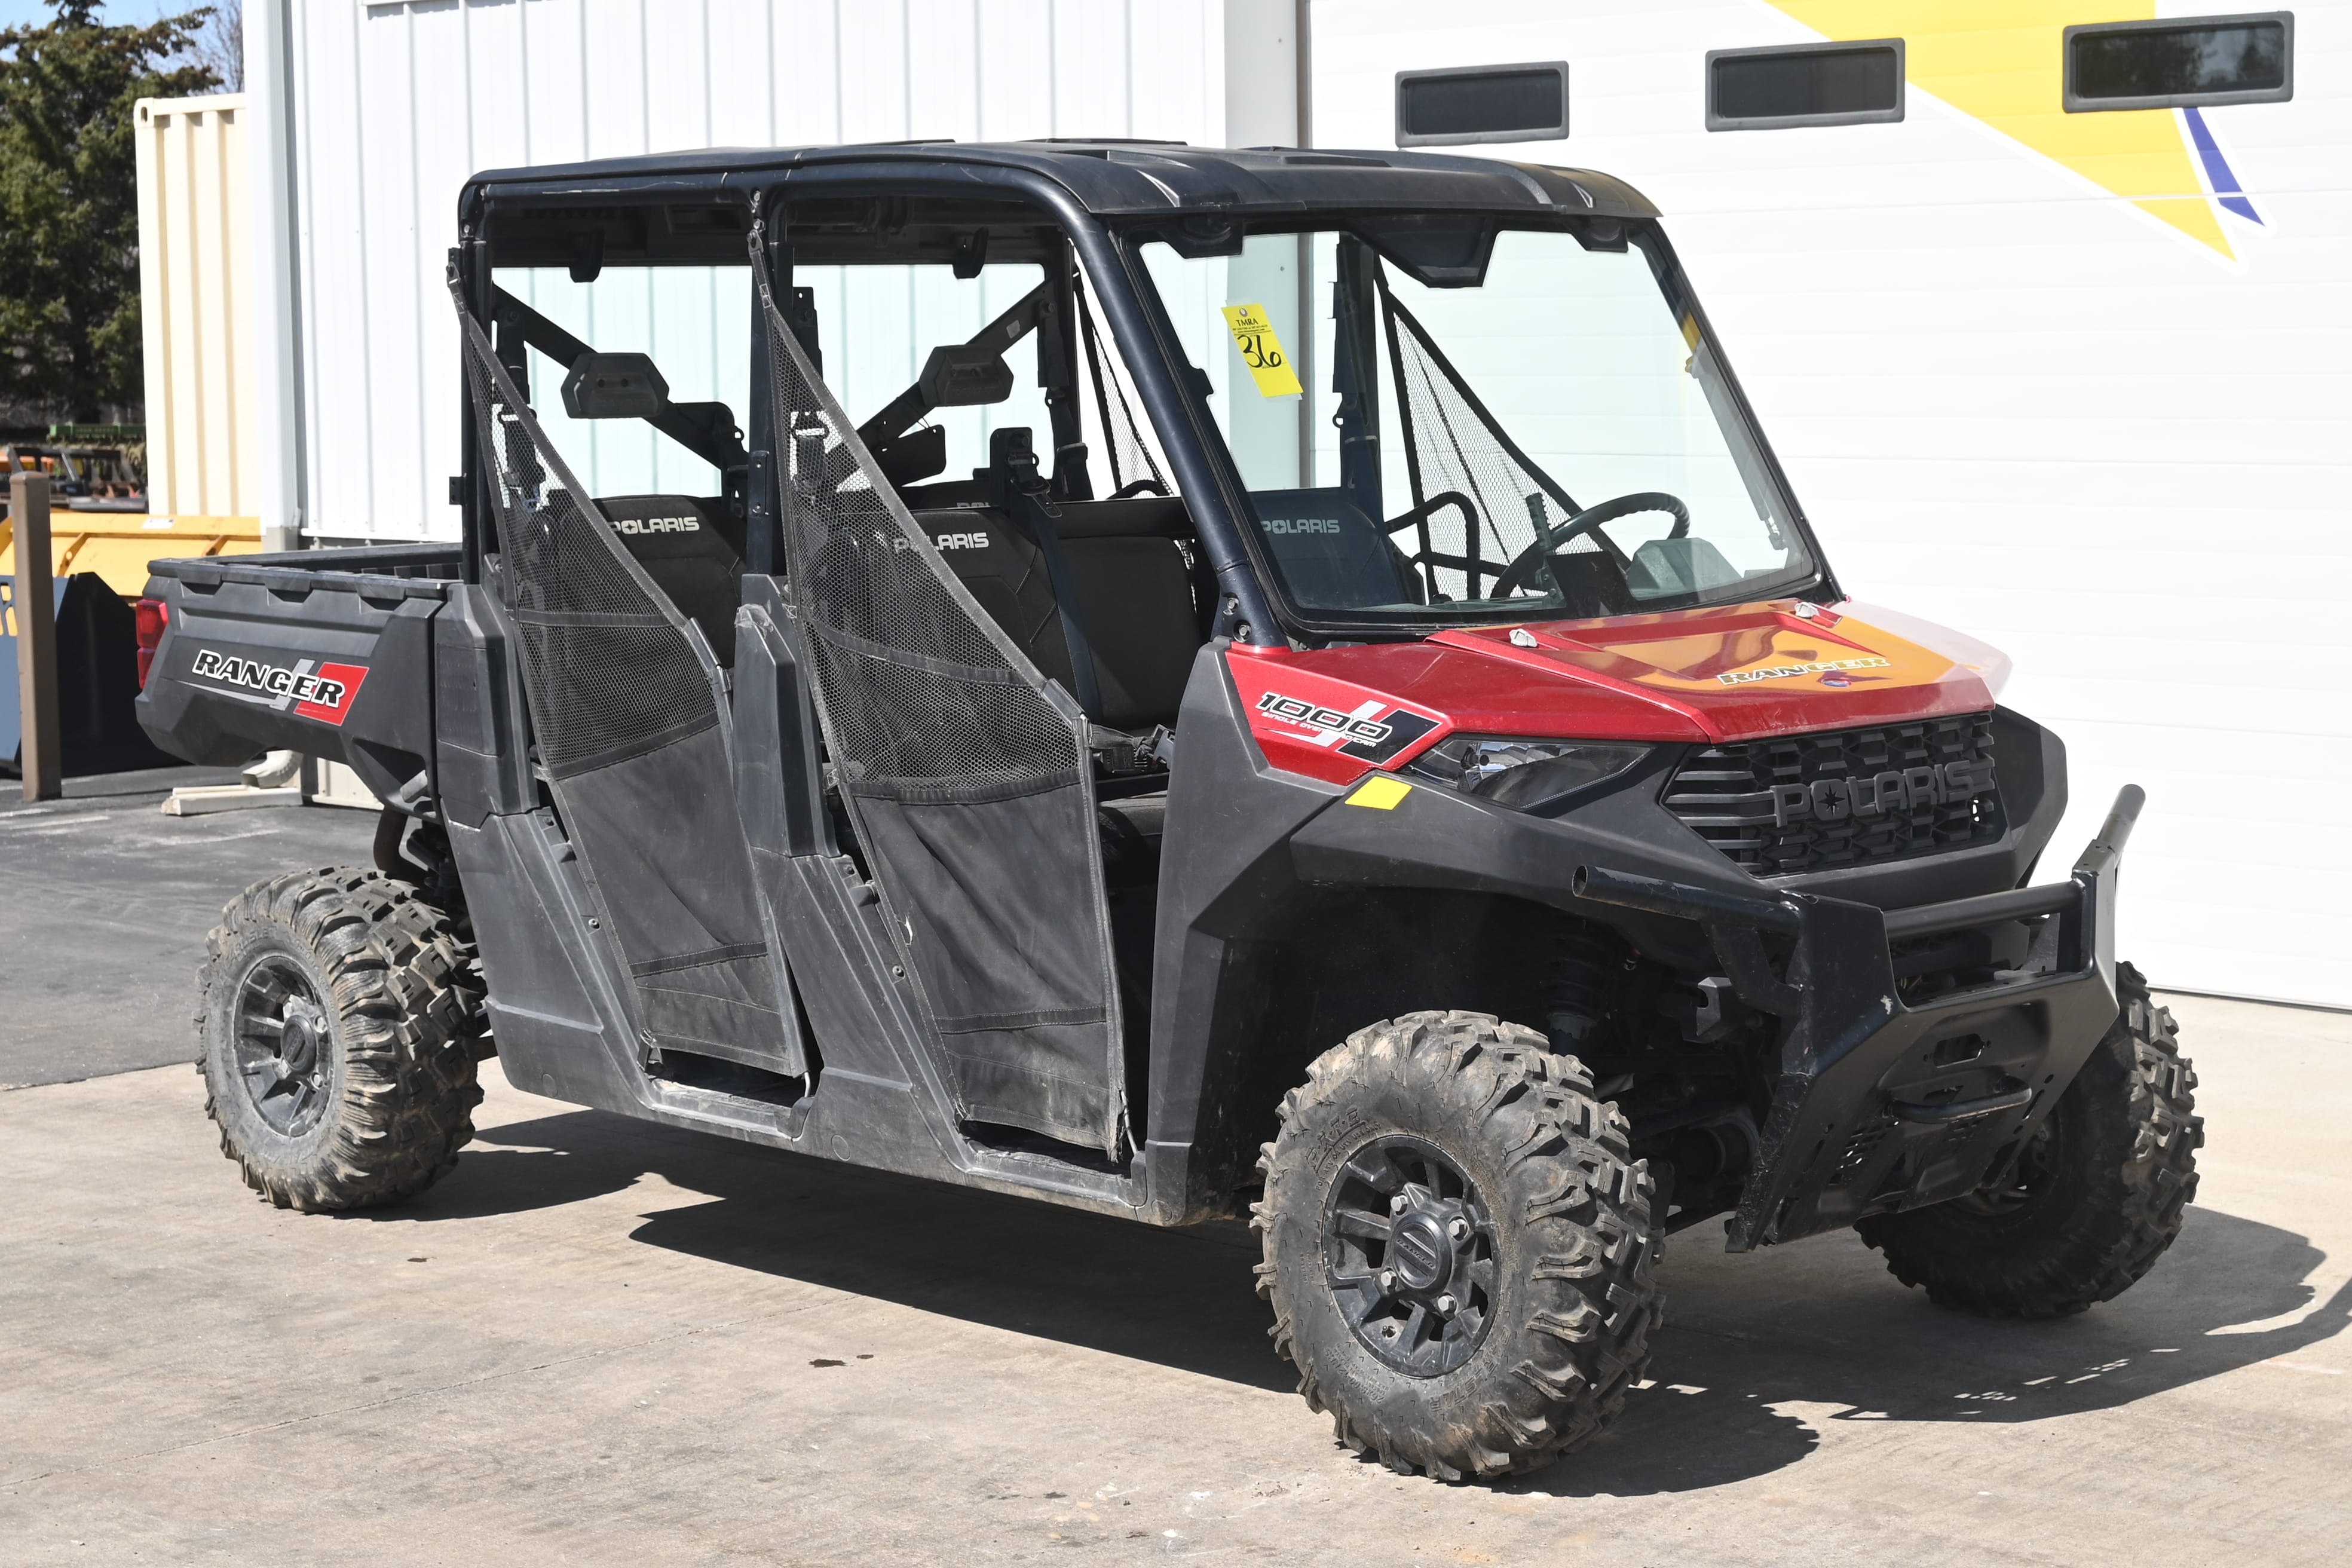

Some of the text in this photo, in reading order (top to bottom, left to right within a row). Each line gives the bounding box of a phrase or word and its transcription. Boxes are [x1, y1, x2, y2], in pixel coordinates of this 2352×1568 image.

[1235, 318, 1258, 327] TMRA
[1237, 334, 1282, 368] 36
[191, 649, 345, 708] RANGER
[1716, 657, 1892, 685] RANGER
[1255, 691, 1394, 743] 1000
[1261, 711, 1297, 725] SINGLE
[1769, 760, 1973, 828] POLARIS
